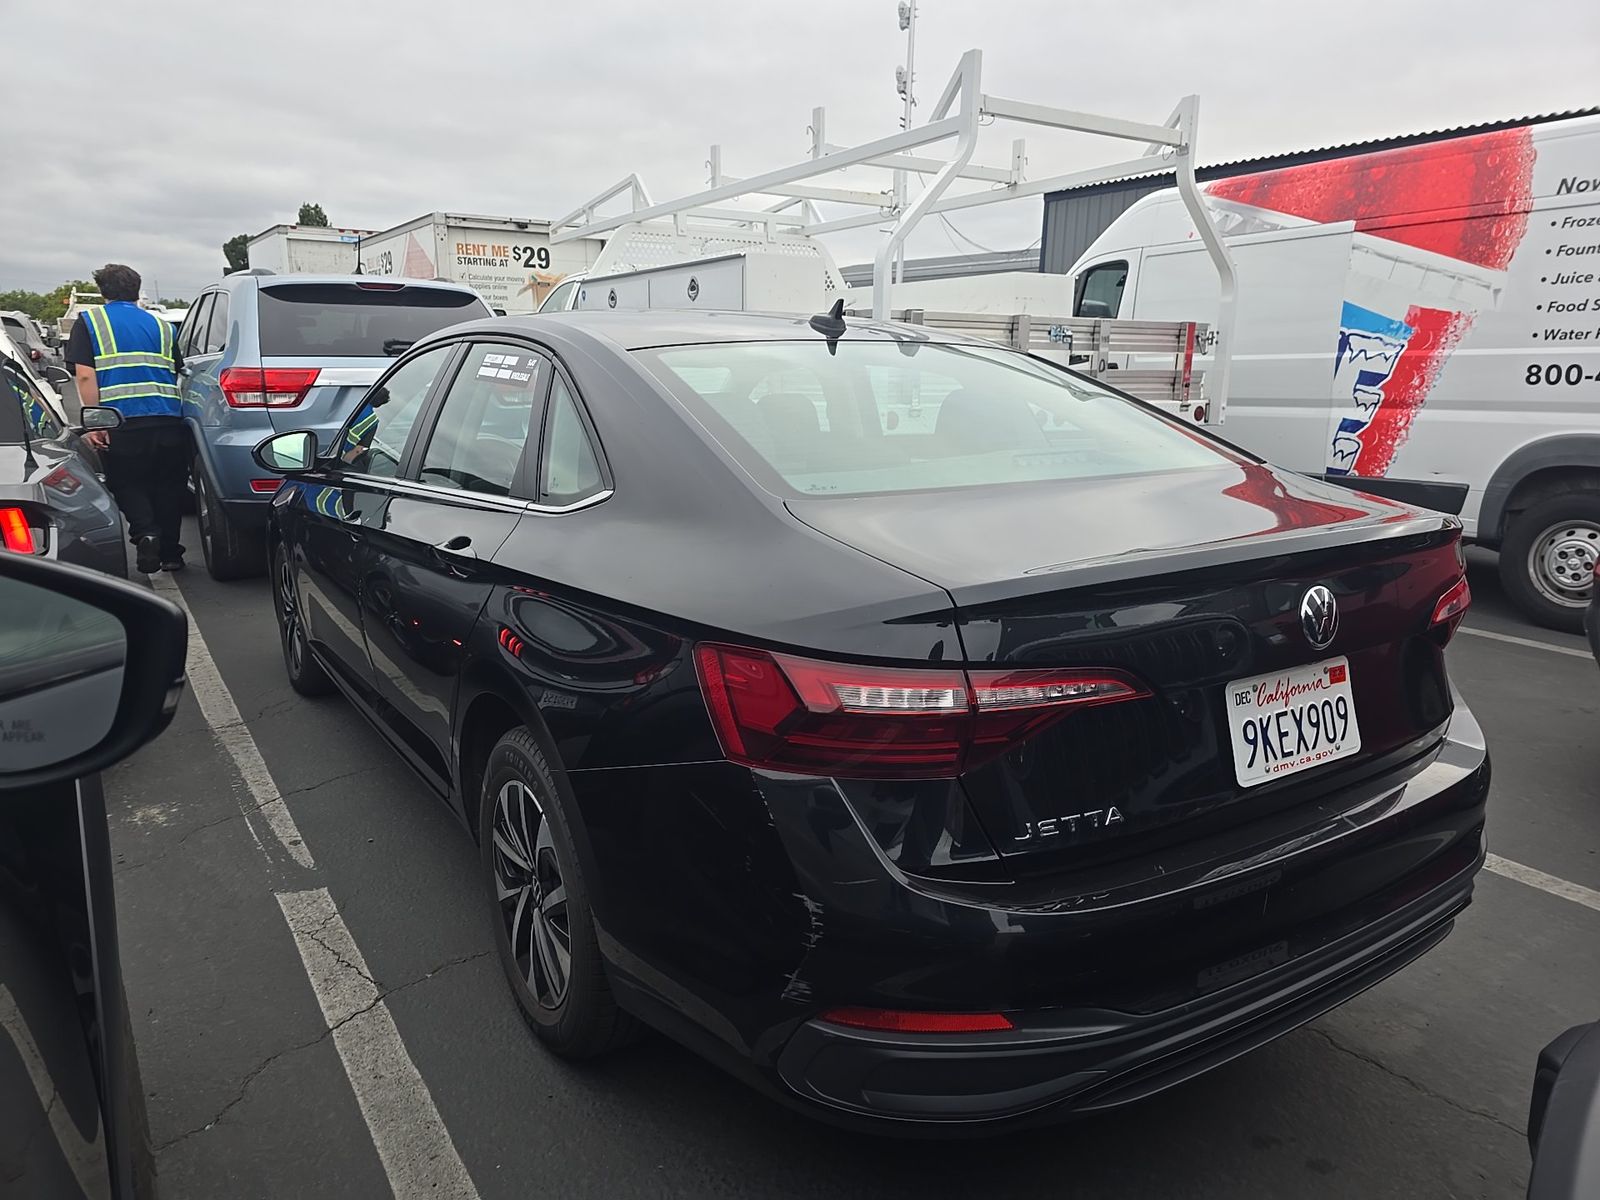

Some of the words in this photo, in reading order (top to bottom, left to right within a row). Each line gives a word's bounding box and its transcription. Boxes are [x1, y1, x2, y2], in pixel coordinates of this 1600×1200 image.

[456, 243, 488, 256] RENT
[491, 245, 510, 257] ME
[512, 245, 551, 269] $29
[457, 256, 497, 267] STARTING
[499, 259, 509, 268] AT
[468, 273, 493, 282] Calculate
[494, 275, 506, 284] your
[507, 276, 526, 284] moving
[1550, 271, 1594, 285] Juice
[1546, 298, 1590, 313] Food
[1543, 329, 1593, 341] Water
[1234, 690, 1252, 707] DEC
[1257, 672, 1331, 708] California
[1242, 695, 1349, 769] 9KEX909
[1272, 748, 1335, 774] dmv.ca.gov
[1014, 805, 1125, 841] JETTA
